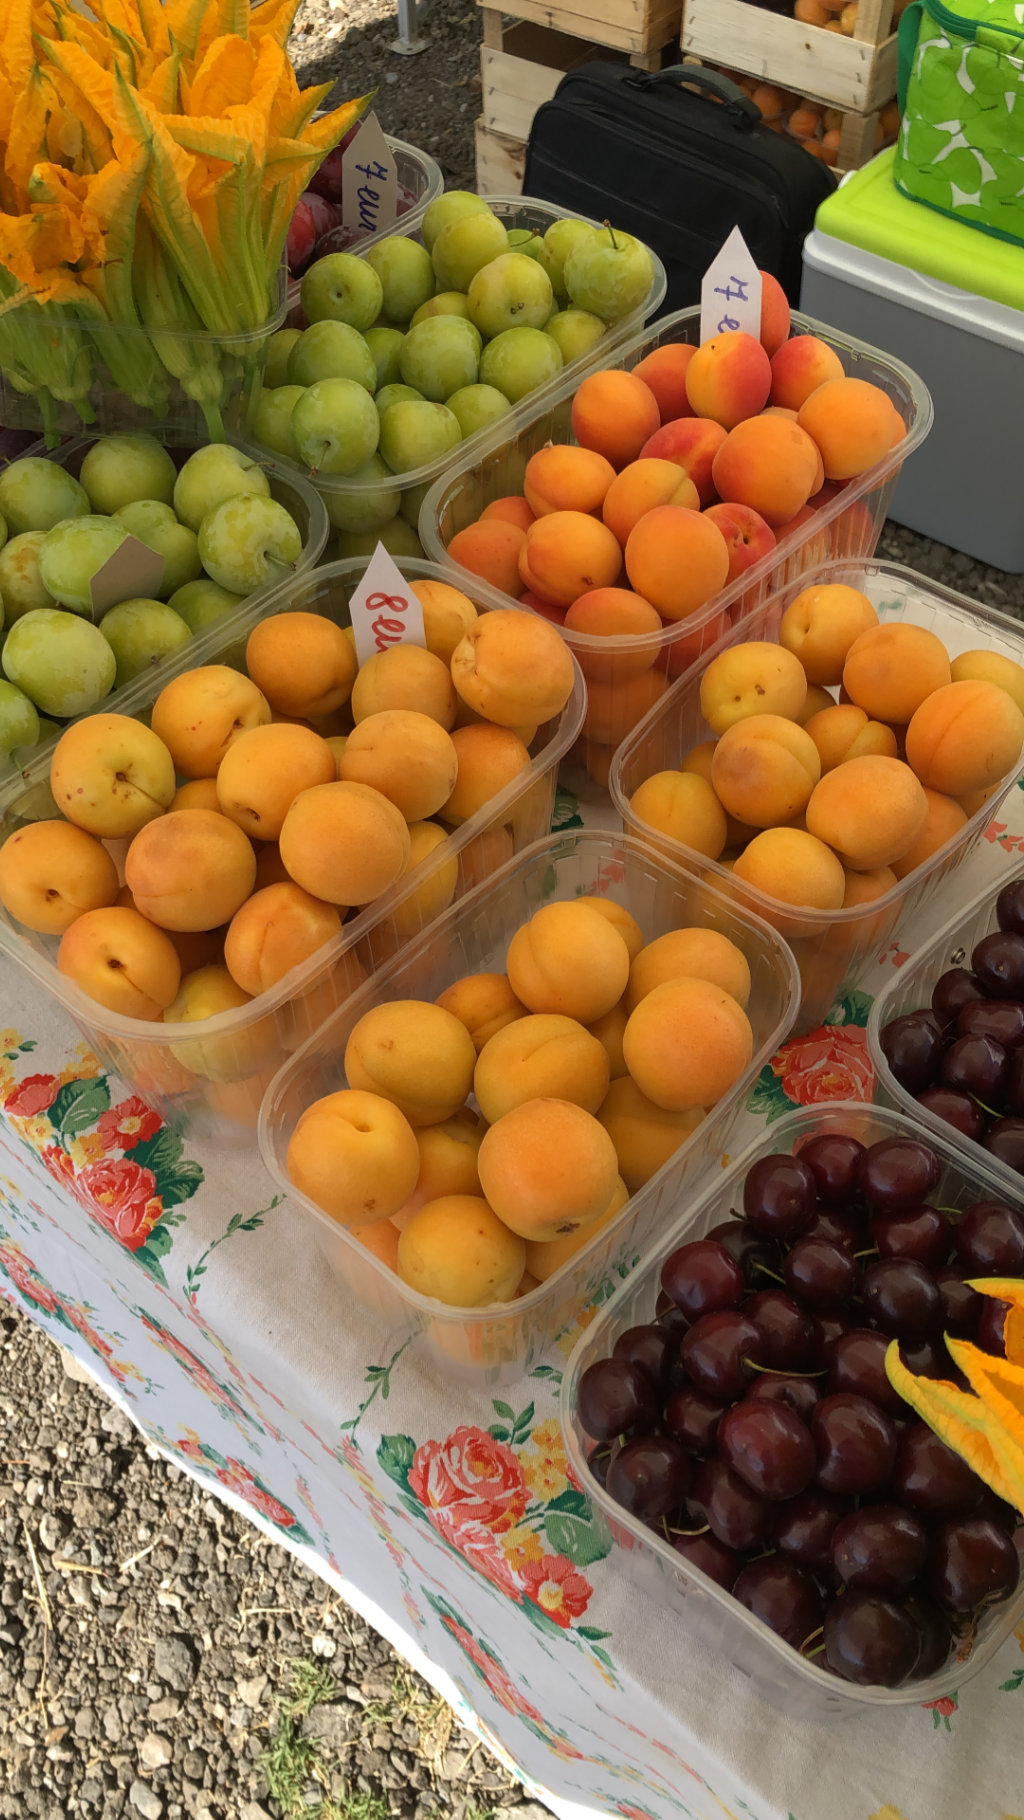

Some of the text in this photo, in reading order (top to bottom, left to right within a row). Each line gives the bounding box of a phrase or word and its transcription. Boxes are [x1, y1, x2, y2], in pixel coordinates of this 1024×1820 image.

[355, 161, 388, 232] 7 eur
[714, 276, 749, 302] 7
[365, 592, 409, 654] 8 eu
